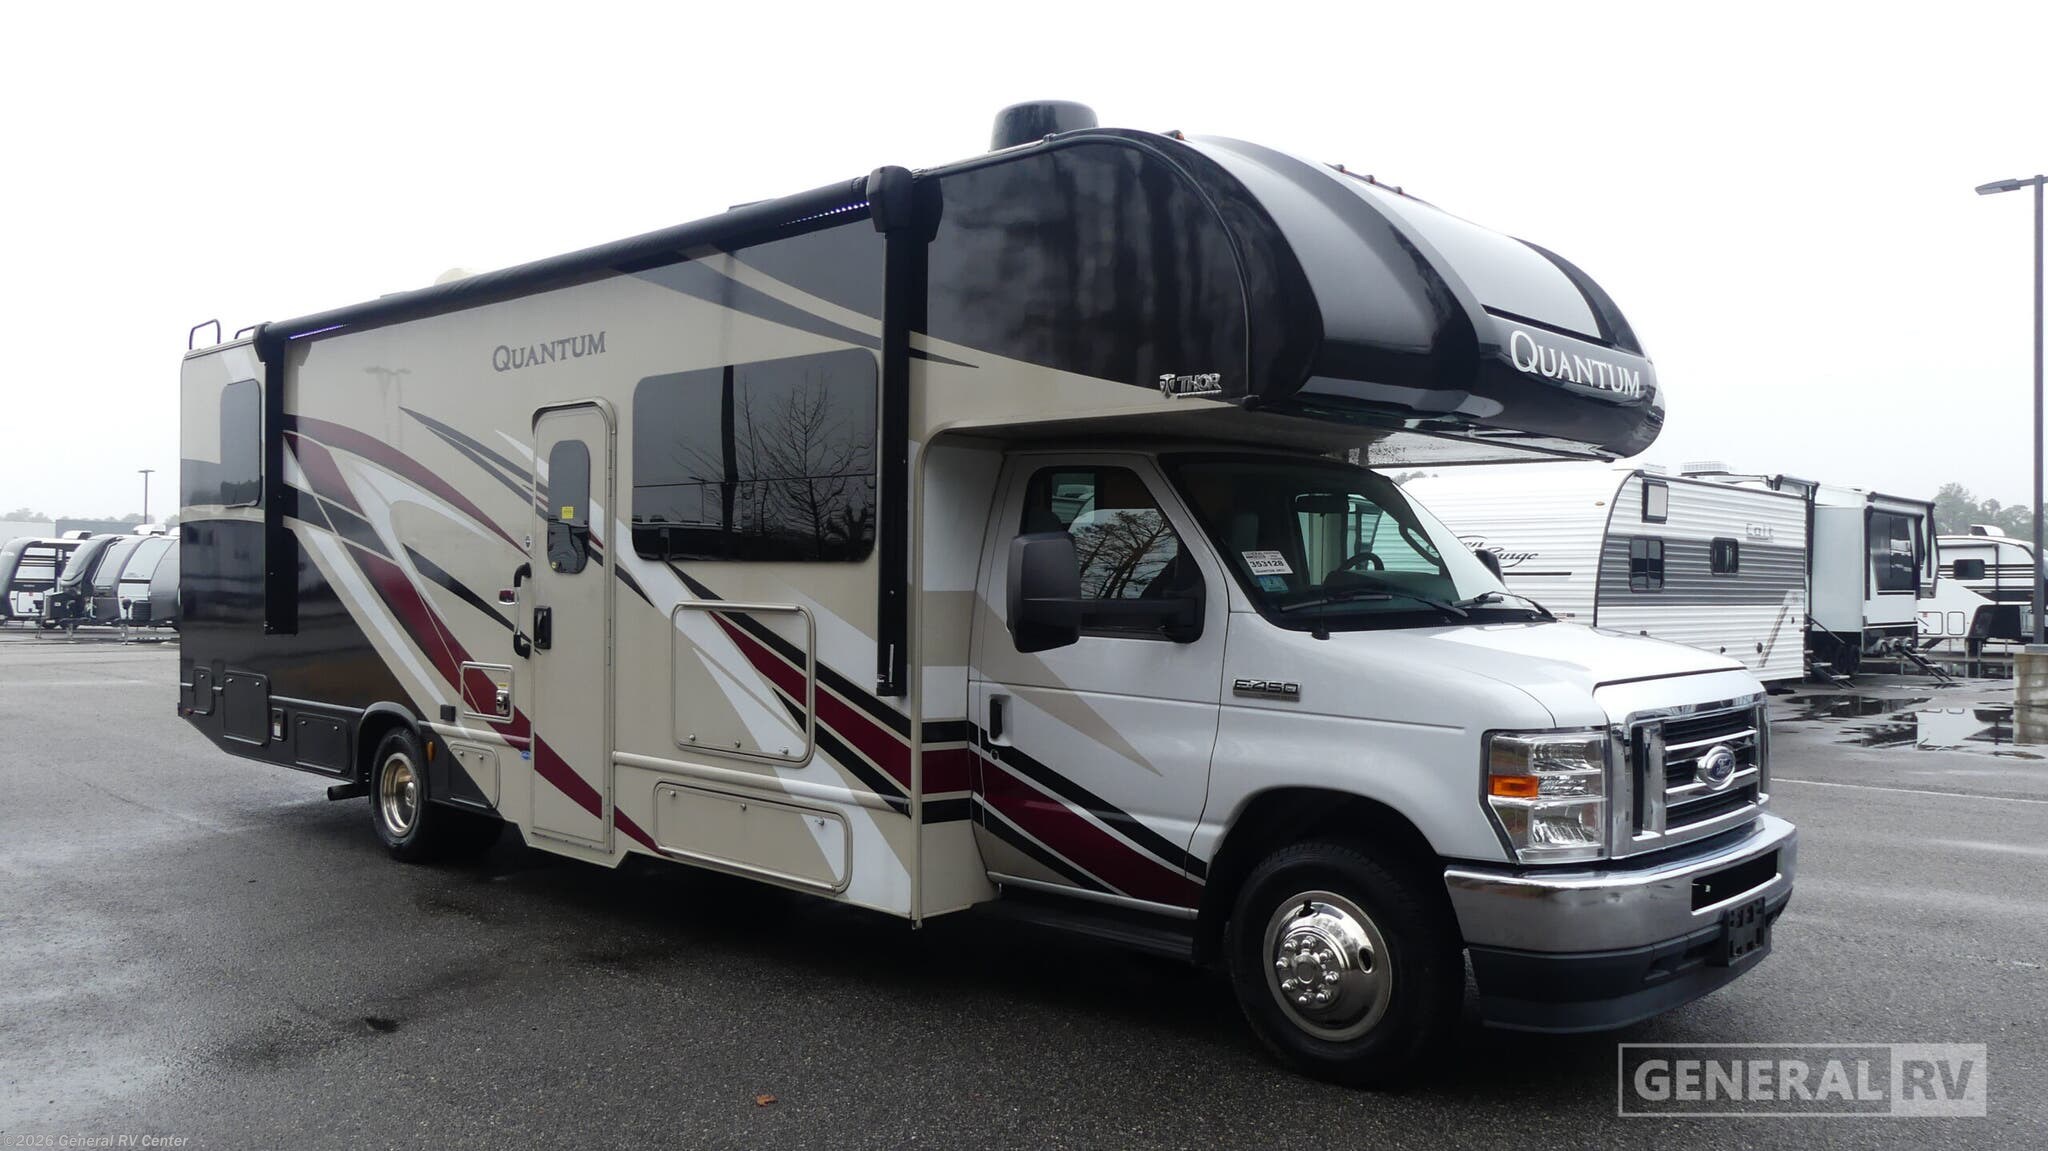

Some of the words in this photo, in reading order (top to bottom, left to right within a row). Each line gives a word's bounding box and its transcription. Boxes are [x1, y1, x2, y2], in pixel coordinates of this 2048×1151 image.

[492, 331, 606, 372] QUANTUM
[1510, 330, 1640, 398] QUANTUM
[1176, 373, 1222, 393] THOR
